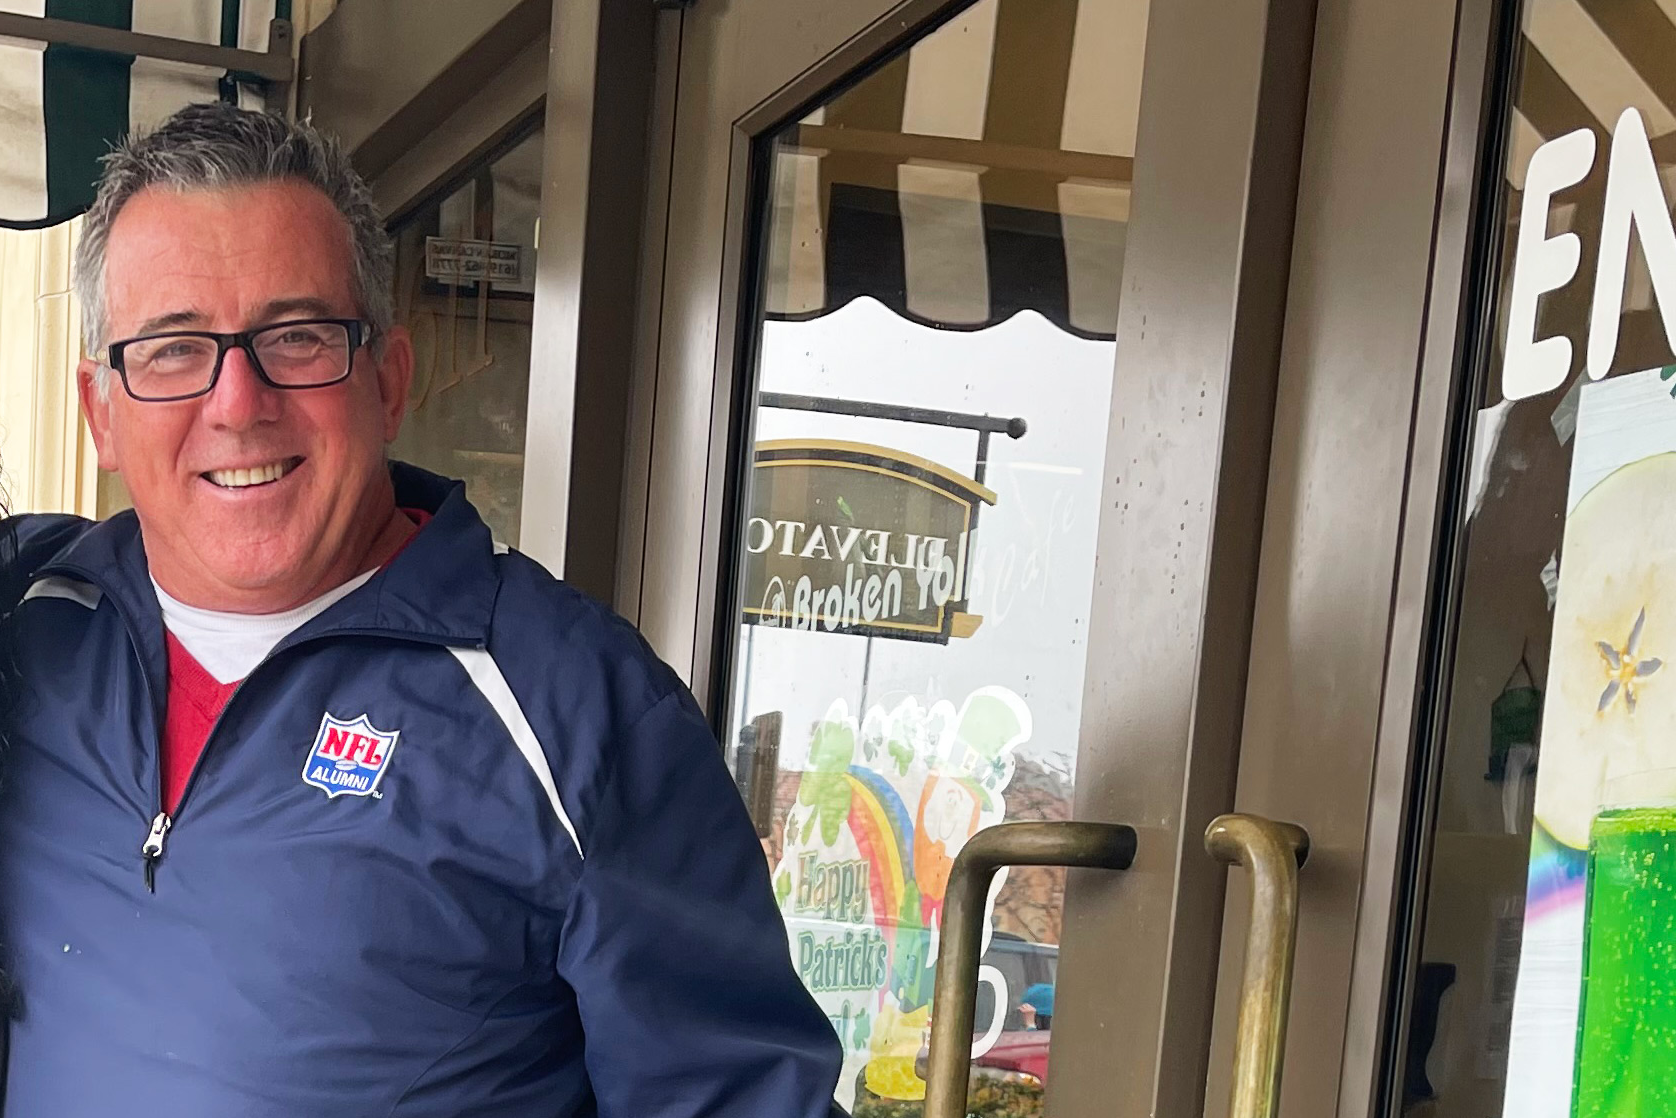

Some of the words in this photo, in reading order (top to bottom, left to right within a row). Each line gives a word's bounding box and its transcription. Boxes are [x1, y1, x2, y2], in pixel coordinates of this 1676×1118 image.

[792, 564, 903, 632] Broken
[916, 528, 987, 611] Yolk
[320, 727, 382, 766] NFL
[310, 765, 370, 791] ALUMNI
[794, 851, 870, 924] Happy
[797, 930, 888, 992] Patrick's
